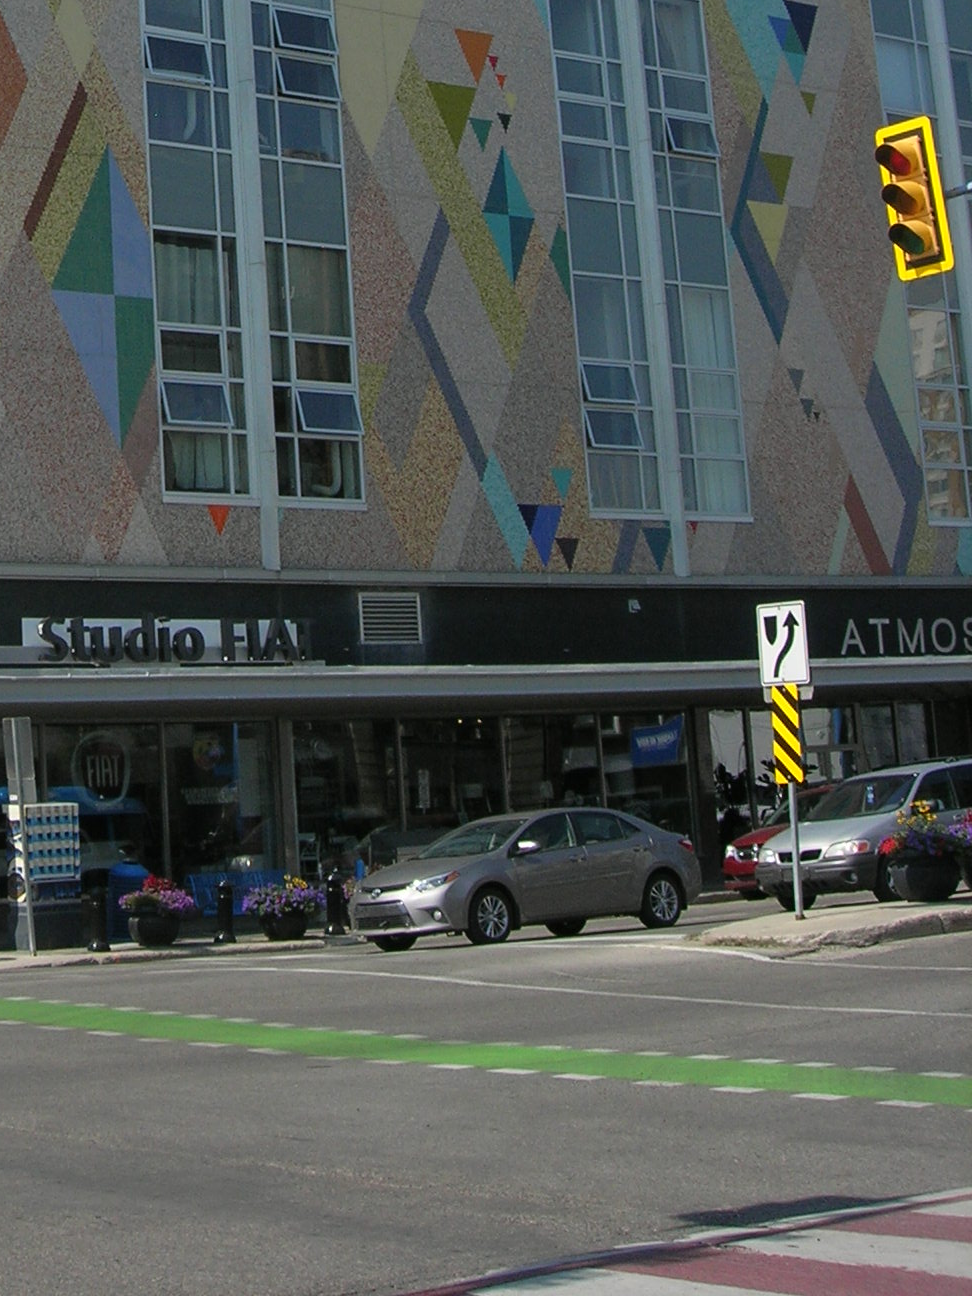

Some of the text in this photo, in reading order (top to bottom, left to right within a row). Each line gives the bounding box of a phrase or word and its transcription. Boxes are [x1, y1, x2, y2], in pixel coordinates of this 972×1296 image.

[36, 614, 317, 663] Studio FIAT
[87, 754, 120, 788] FIAT
